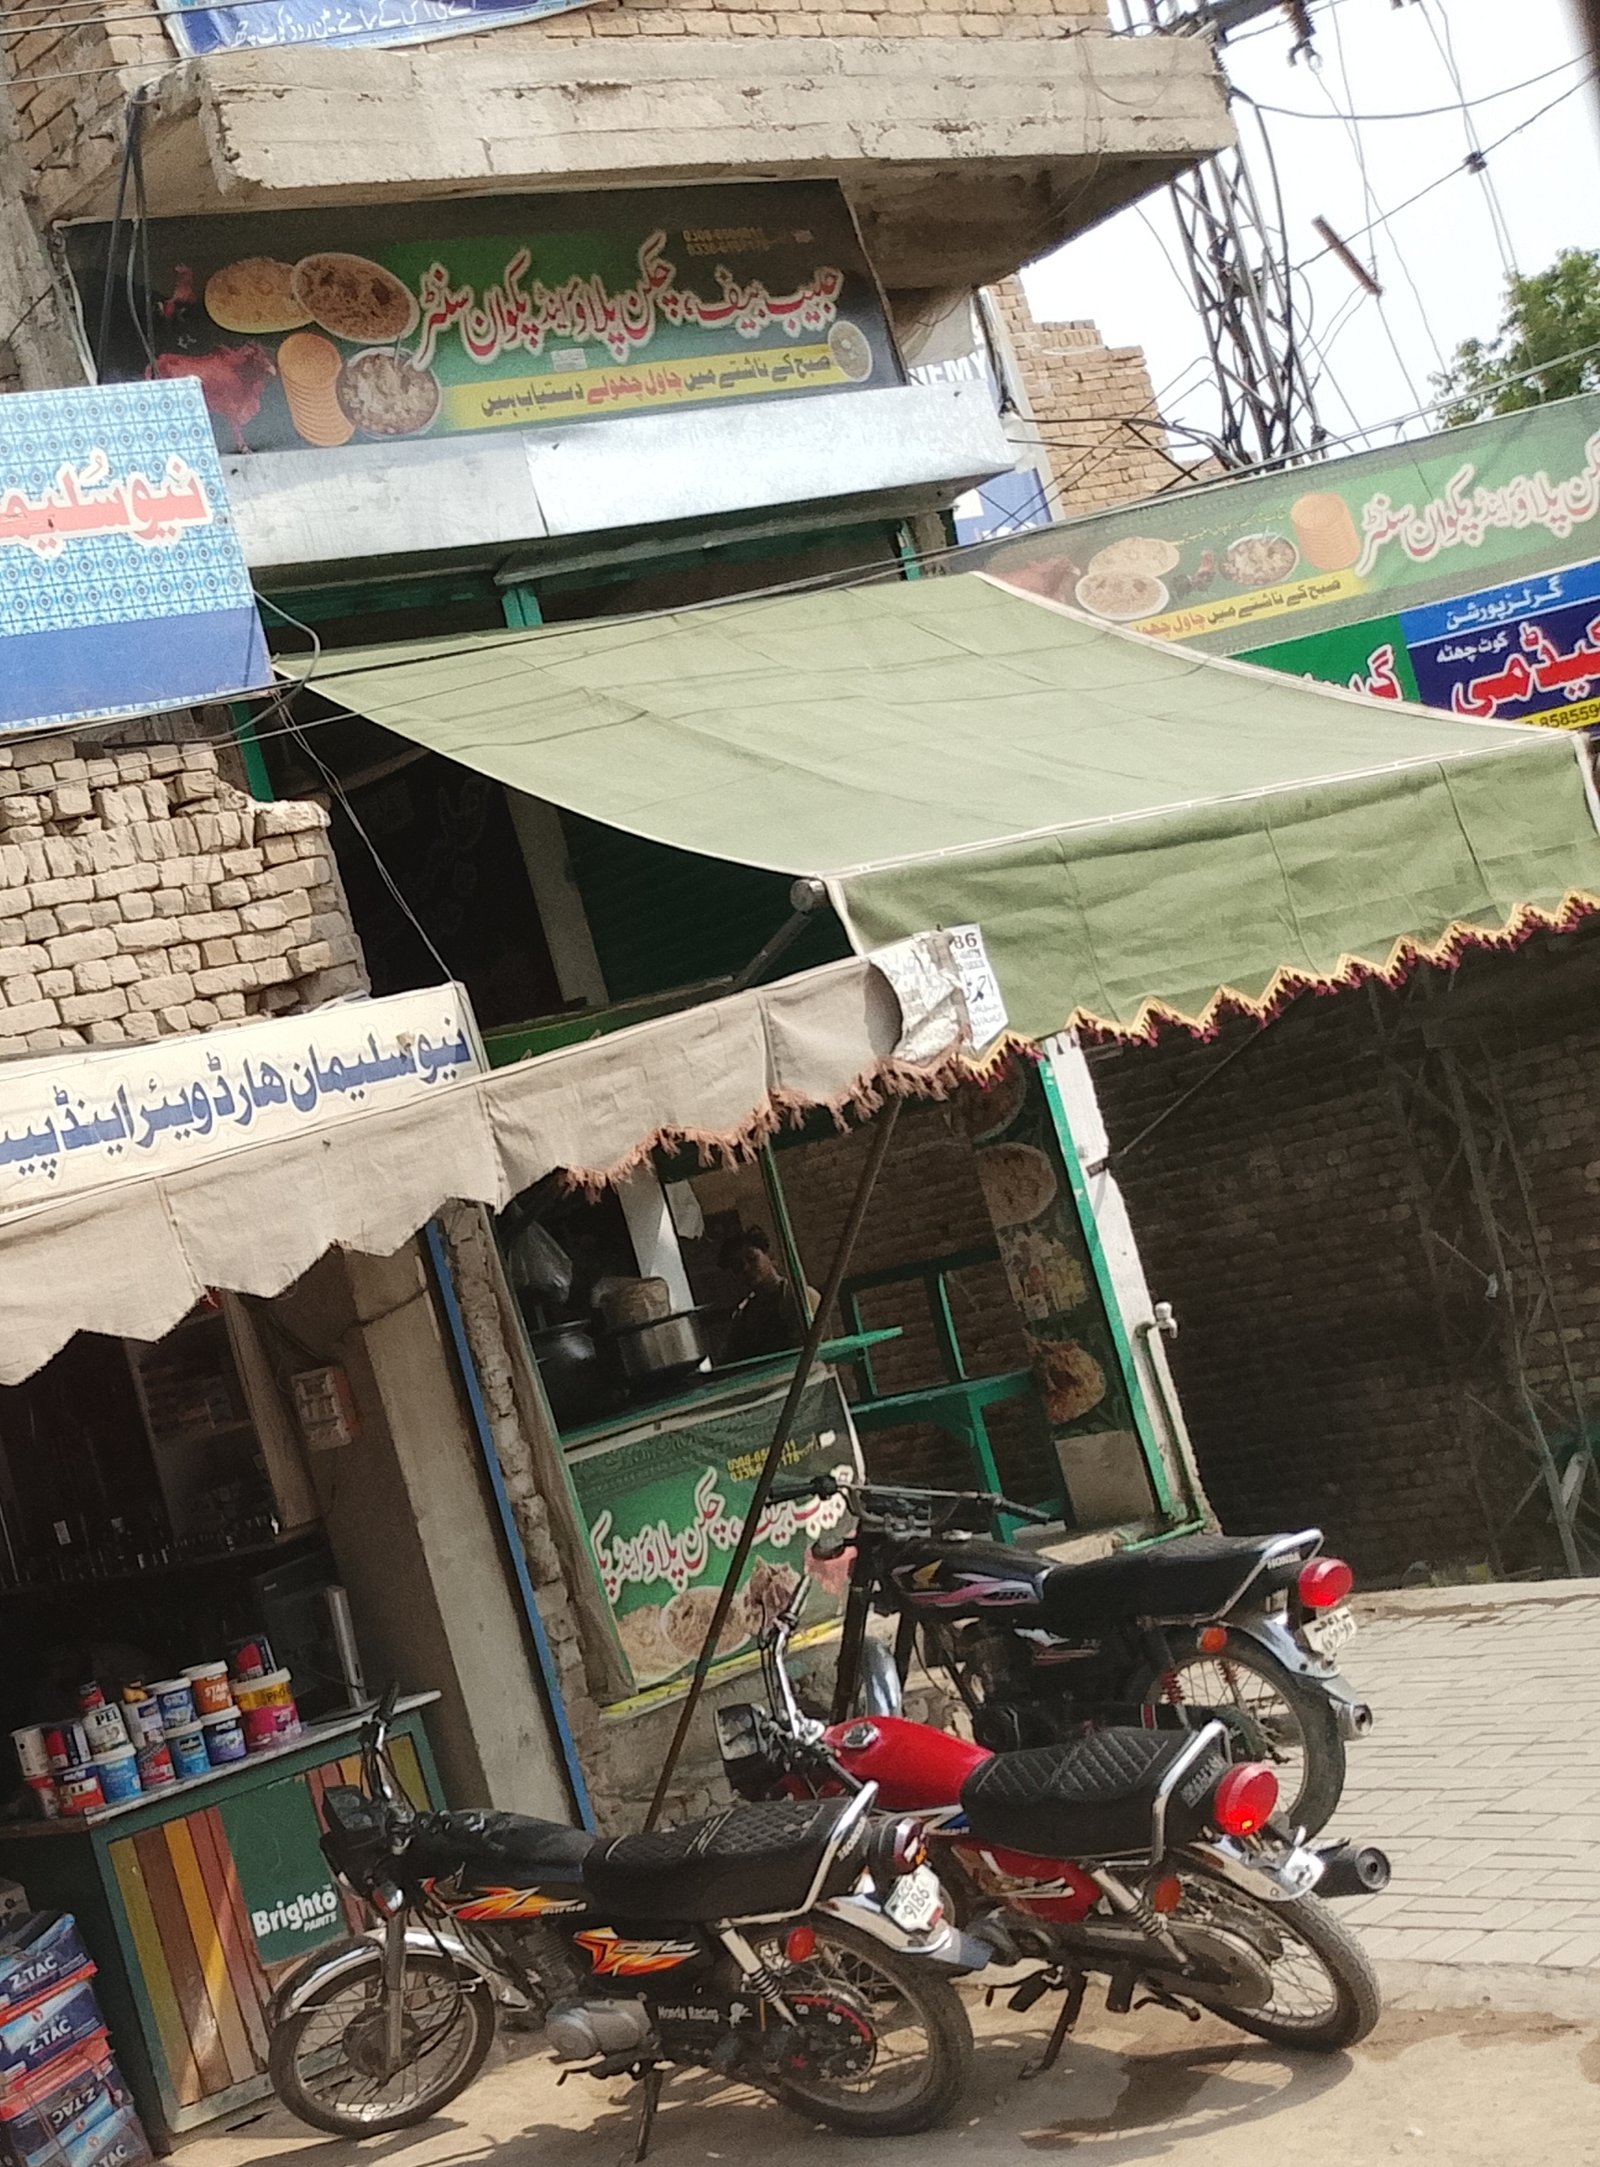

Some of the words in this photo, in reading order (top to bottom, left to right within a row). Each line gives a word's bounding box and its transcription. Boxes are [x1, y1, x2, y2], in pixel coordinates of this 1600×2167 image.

[617, 230, 686, 346] چکن
[763, 266, 844, 338] حبیب
[411, 262, 473, 372] سنٹر
[460, 247, 543, 365] پکوان
[643, 365, 683, 398] چاول
[683, 368, 716, 392] میں
[718, 356, 770, 389] ناشتے
[770, 353, 796, 382] کے
[796, 352, 831, 379] صبح
[480, 390, 517, 418] ہیں
[515, 380, 583, 413] دستیاب
[586, 371, 644, 405] چھولے
[131, 455, 213, 548] نیو
[1402, 463, 1485, 562] پکوان
[1355, 493, 1414, 577] سنٹر
[1238, 592, 1285, 618] ناشتے
[1285, 586, 1308, 606] کے
[1307, 579, 1341, 600] صبح
[1501, 575, 1564, 613] گرلز
[1173, 609, 1207, 633] چاول
[1207, 605, 1237, 624] میں
[1446, 599, 1506, 630] پورشن
[1436, 643, 1477, 665] چھٹہ
[1475, 630, 1509, 653] کوٹ
[412, 1017, 472, 1084] نیو
[290, 1031, 416, 1113] سلیمان
[53, 1084, 135, 1156] اینڈ
[681, 1466, 731, 1577] چکن
[252, 1889, 337, 1938] Brighto
[303, 1910, 337, 1933] PAINTS
